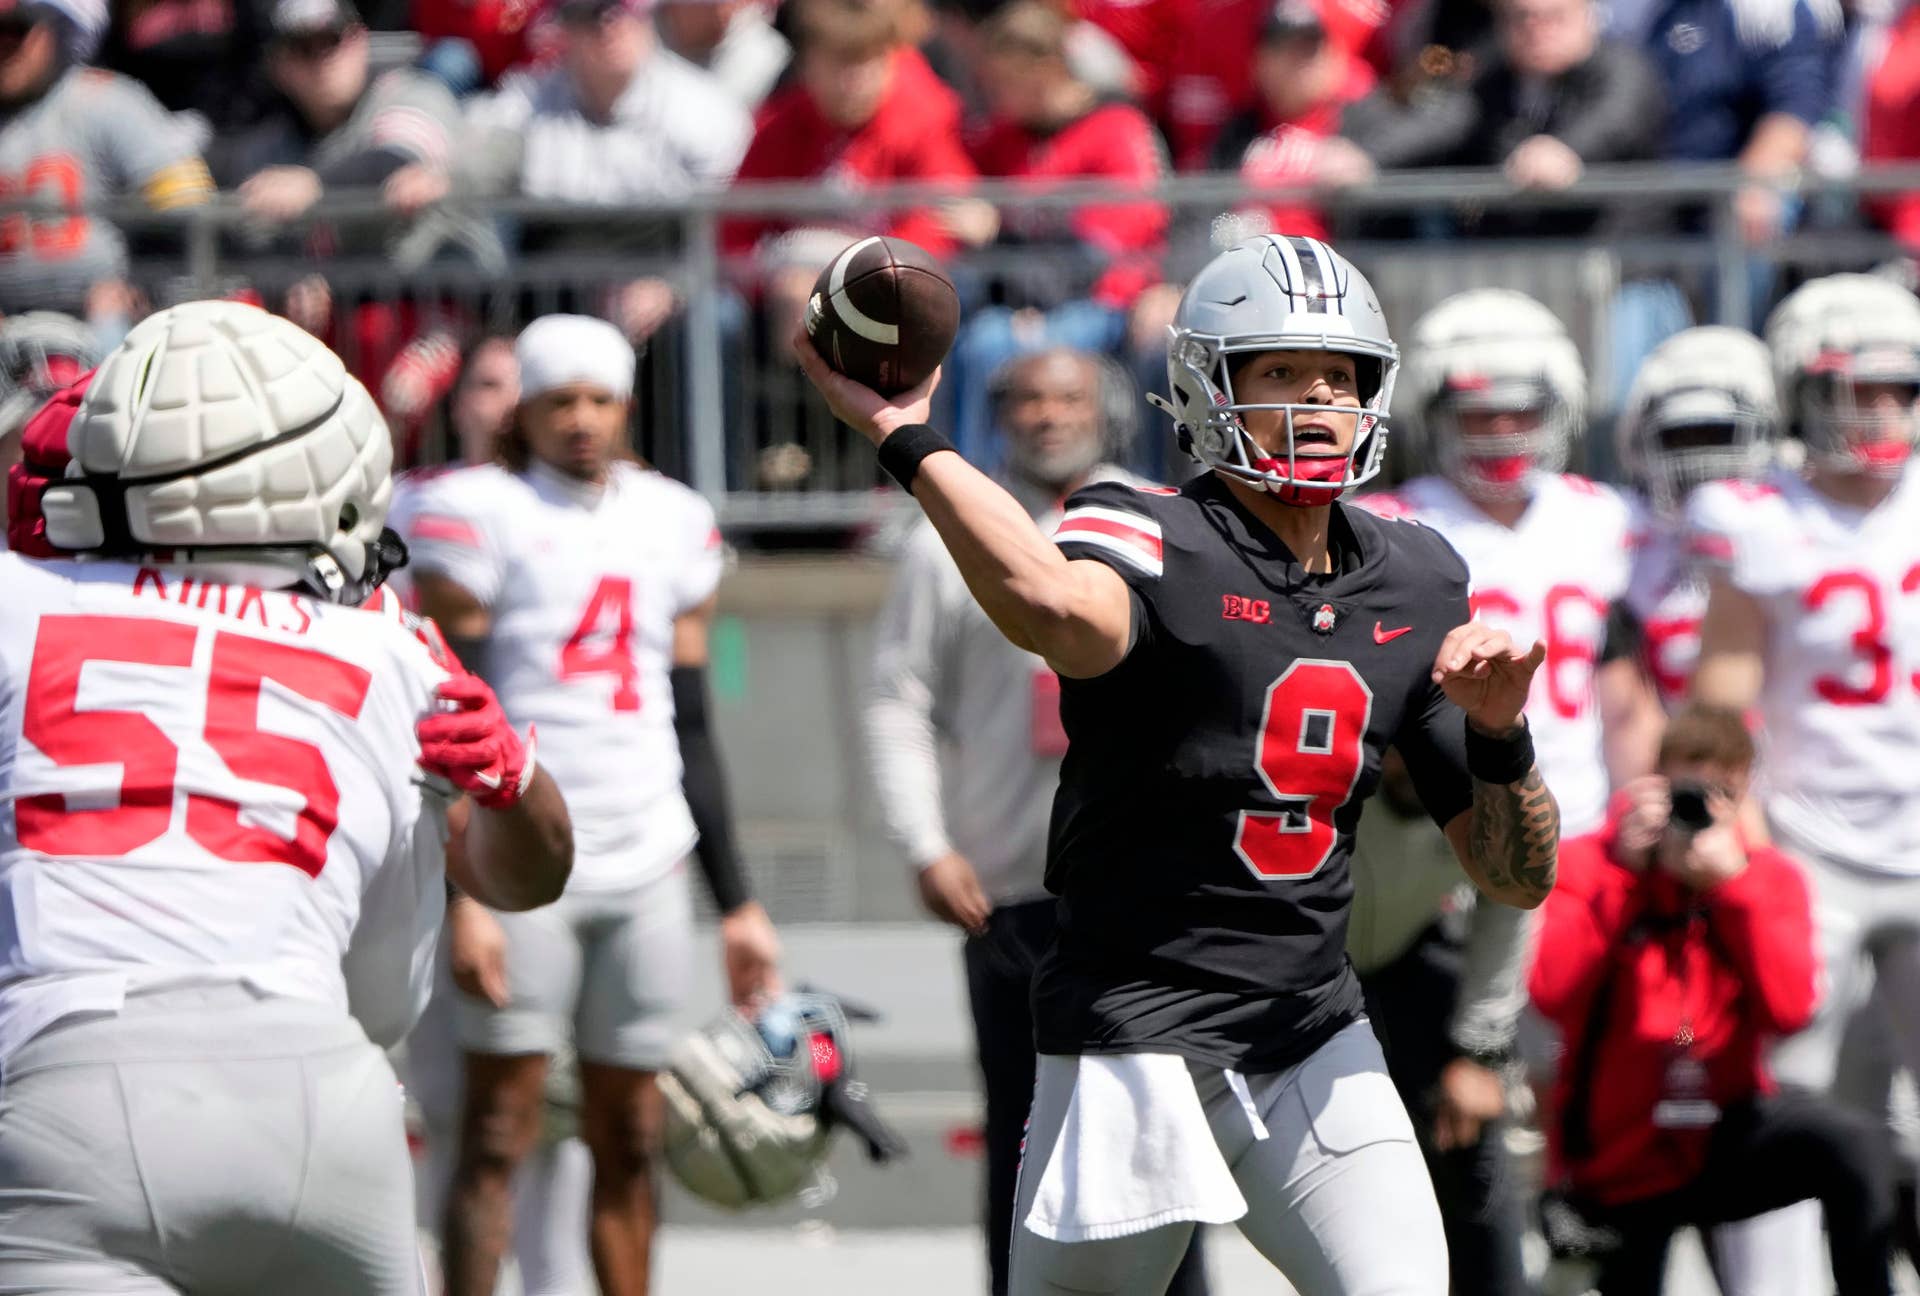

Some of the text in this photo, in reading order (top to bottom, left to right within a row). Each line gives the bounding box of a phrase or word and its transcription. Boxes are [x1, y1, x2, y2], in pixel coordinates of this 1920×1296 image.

[560, 575, 640, 711] 4
[1806, 564, 1920, 707] 3
[14, 614, 373, 880] 55
[1232, 657, 1374, 881] 9
